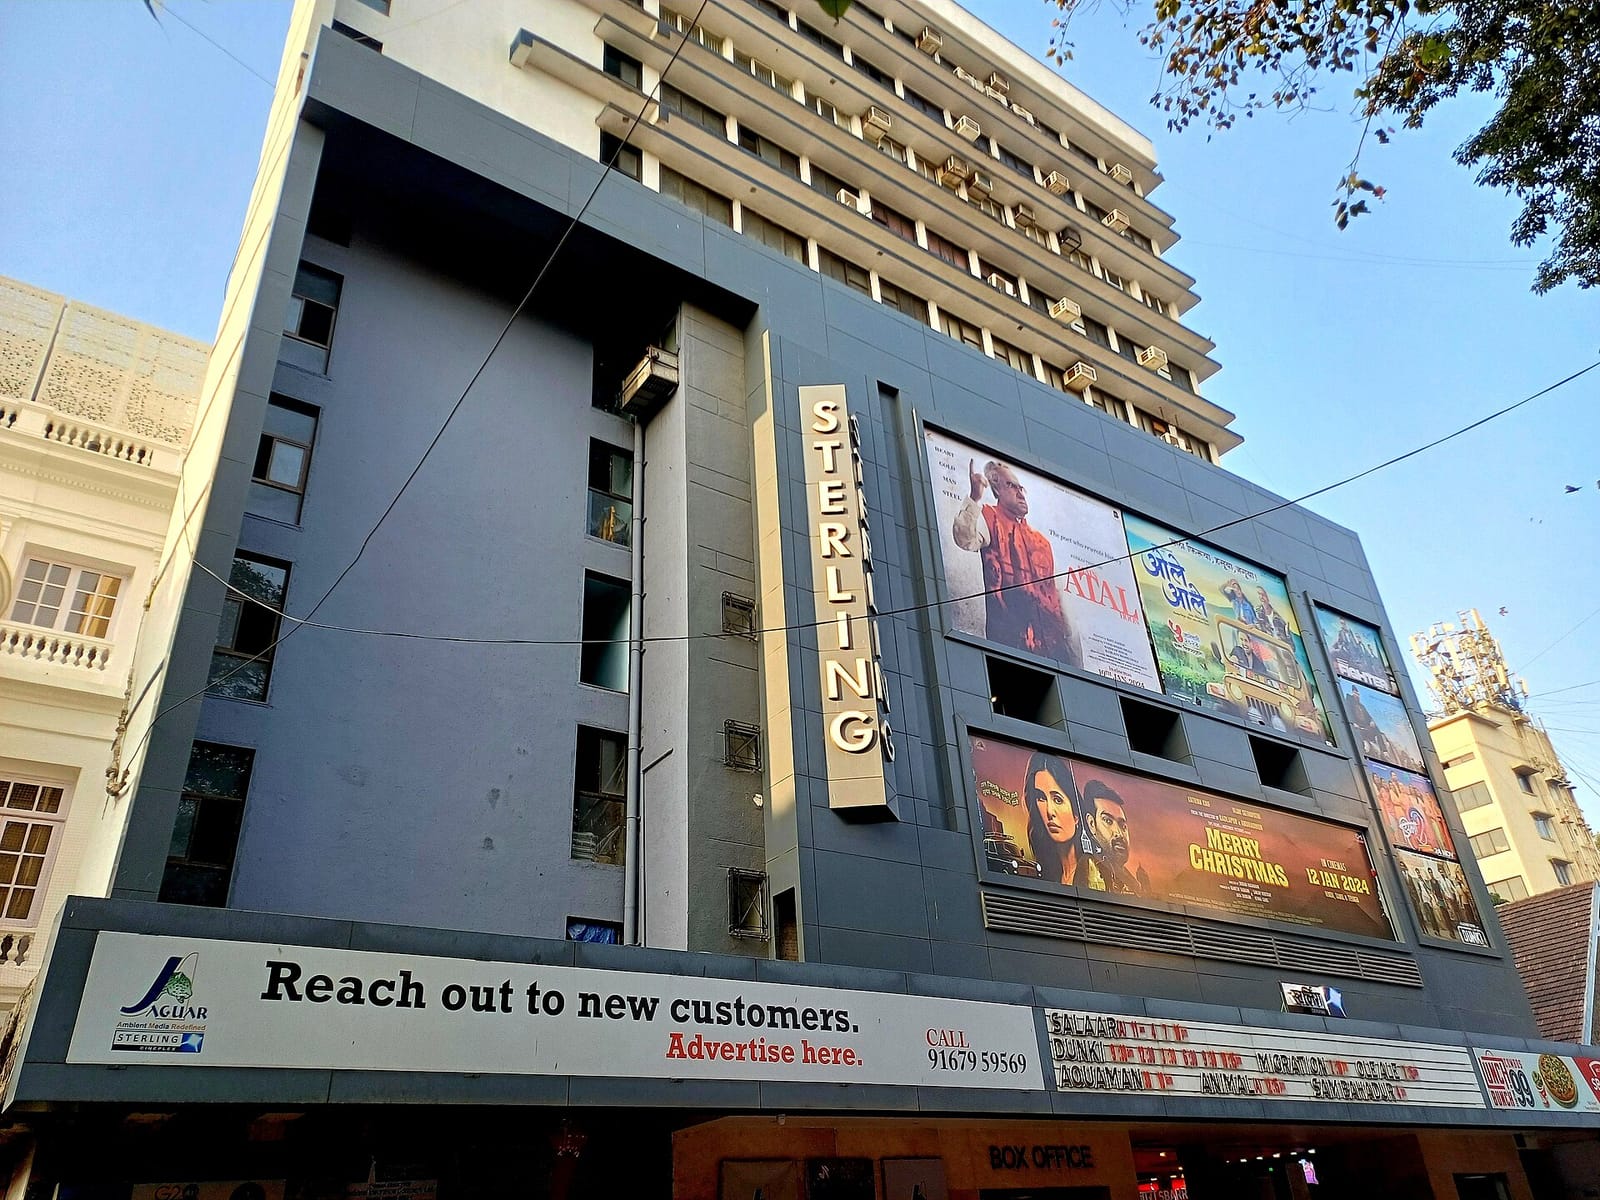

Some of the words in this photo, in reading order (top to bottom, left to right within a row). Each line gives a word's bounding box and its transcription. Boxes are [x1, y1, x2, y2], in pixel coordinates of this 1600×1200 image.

[811, 400, 877, 752] STERLING
[1064, 565, 1140, 621] ATAL
[1205, 826, 1262, 860] MERRY
[1189, 843, 1289, 888] CHRISTMAS
[1306, 867, 1320, 886] 12
[1320, 870, 1340, 889] JAN
[1341, 875, 1370, 895] 2024
[260, 960, 426, 1009] Reach
[441, 978, 513, 1014] out
[526, 980, 565, 1016] to
[577, 992, 659, 1021] new
[670, 995, 859, 1033] customers.
[117, 1021, 147, 1029] Ambient
[148, 1022, 169, 1030] Media
[171, 1023, 206, 1031] Redefined
[117, 1033, 179, 1044] STERLING
[926, 1028, 970, 1048] CALL
[1051, 1013, 1117, 1038] SALAAR
[666, 1032, 795, 1062] Advertise
[801, 1039, 863, 1066] here.
[928, 1048, 977, 1071] 91679
[981, 1051, 1027, 1074] 59569
[1052, 1038, 1105, 1063] DUNKI
[1256, 1052, 1327, 1077] MIGRATION
[1200, 1072, 1254, 1096] ANIMAL
[1509, 1069, 1534, 1107] 99
[989, 1145, 1029, 1169] BOX
[1032, 1145, 1094, 1168] OFFICE
